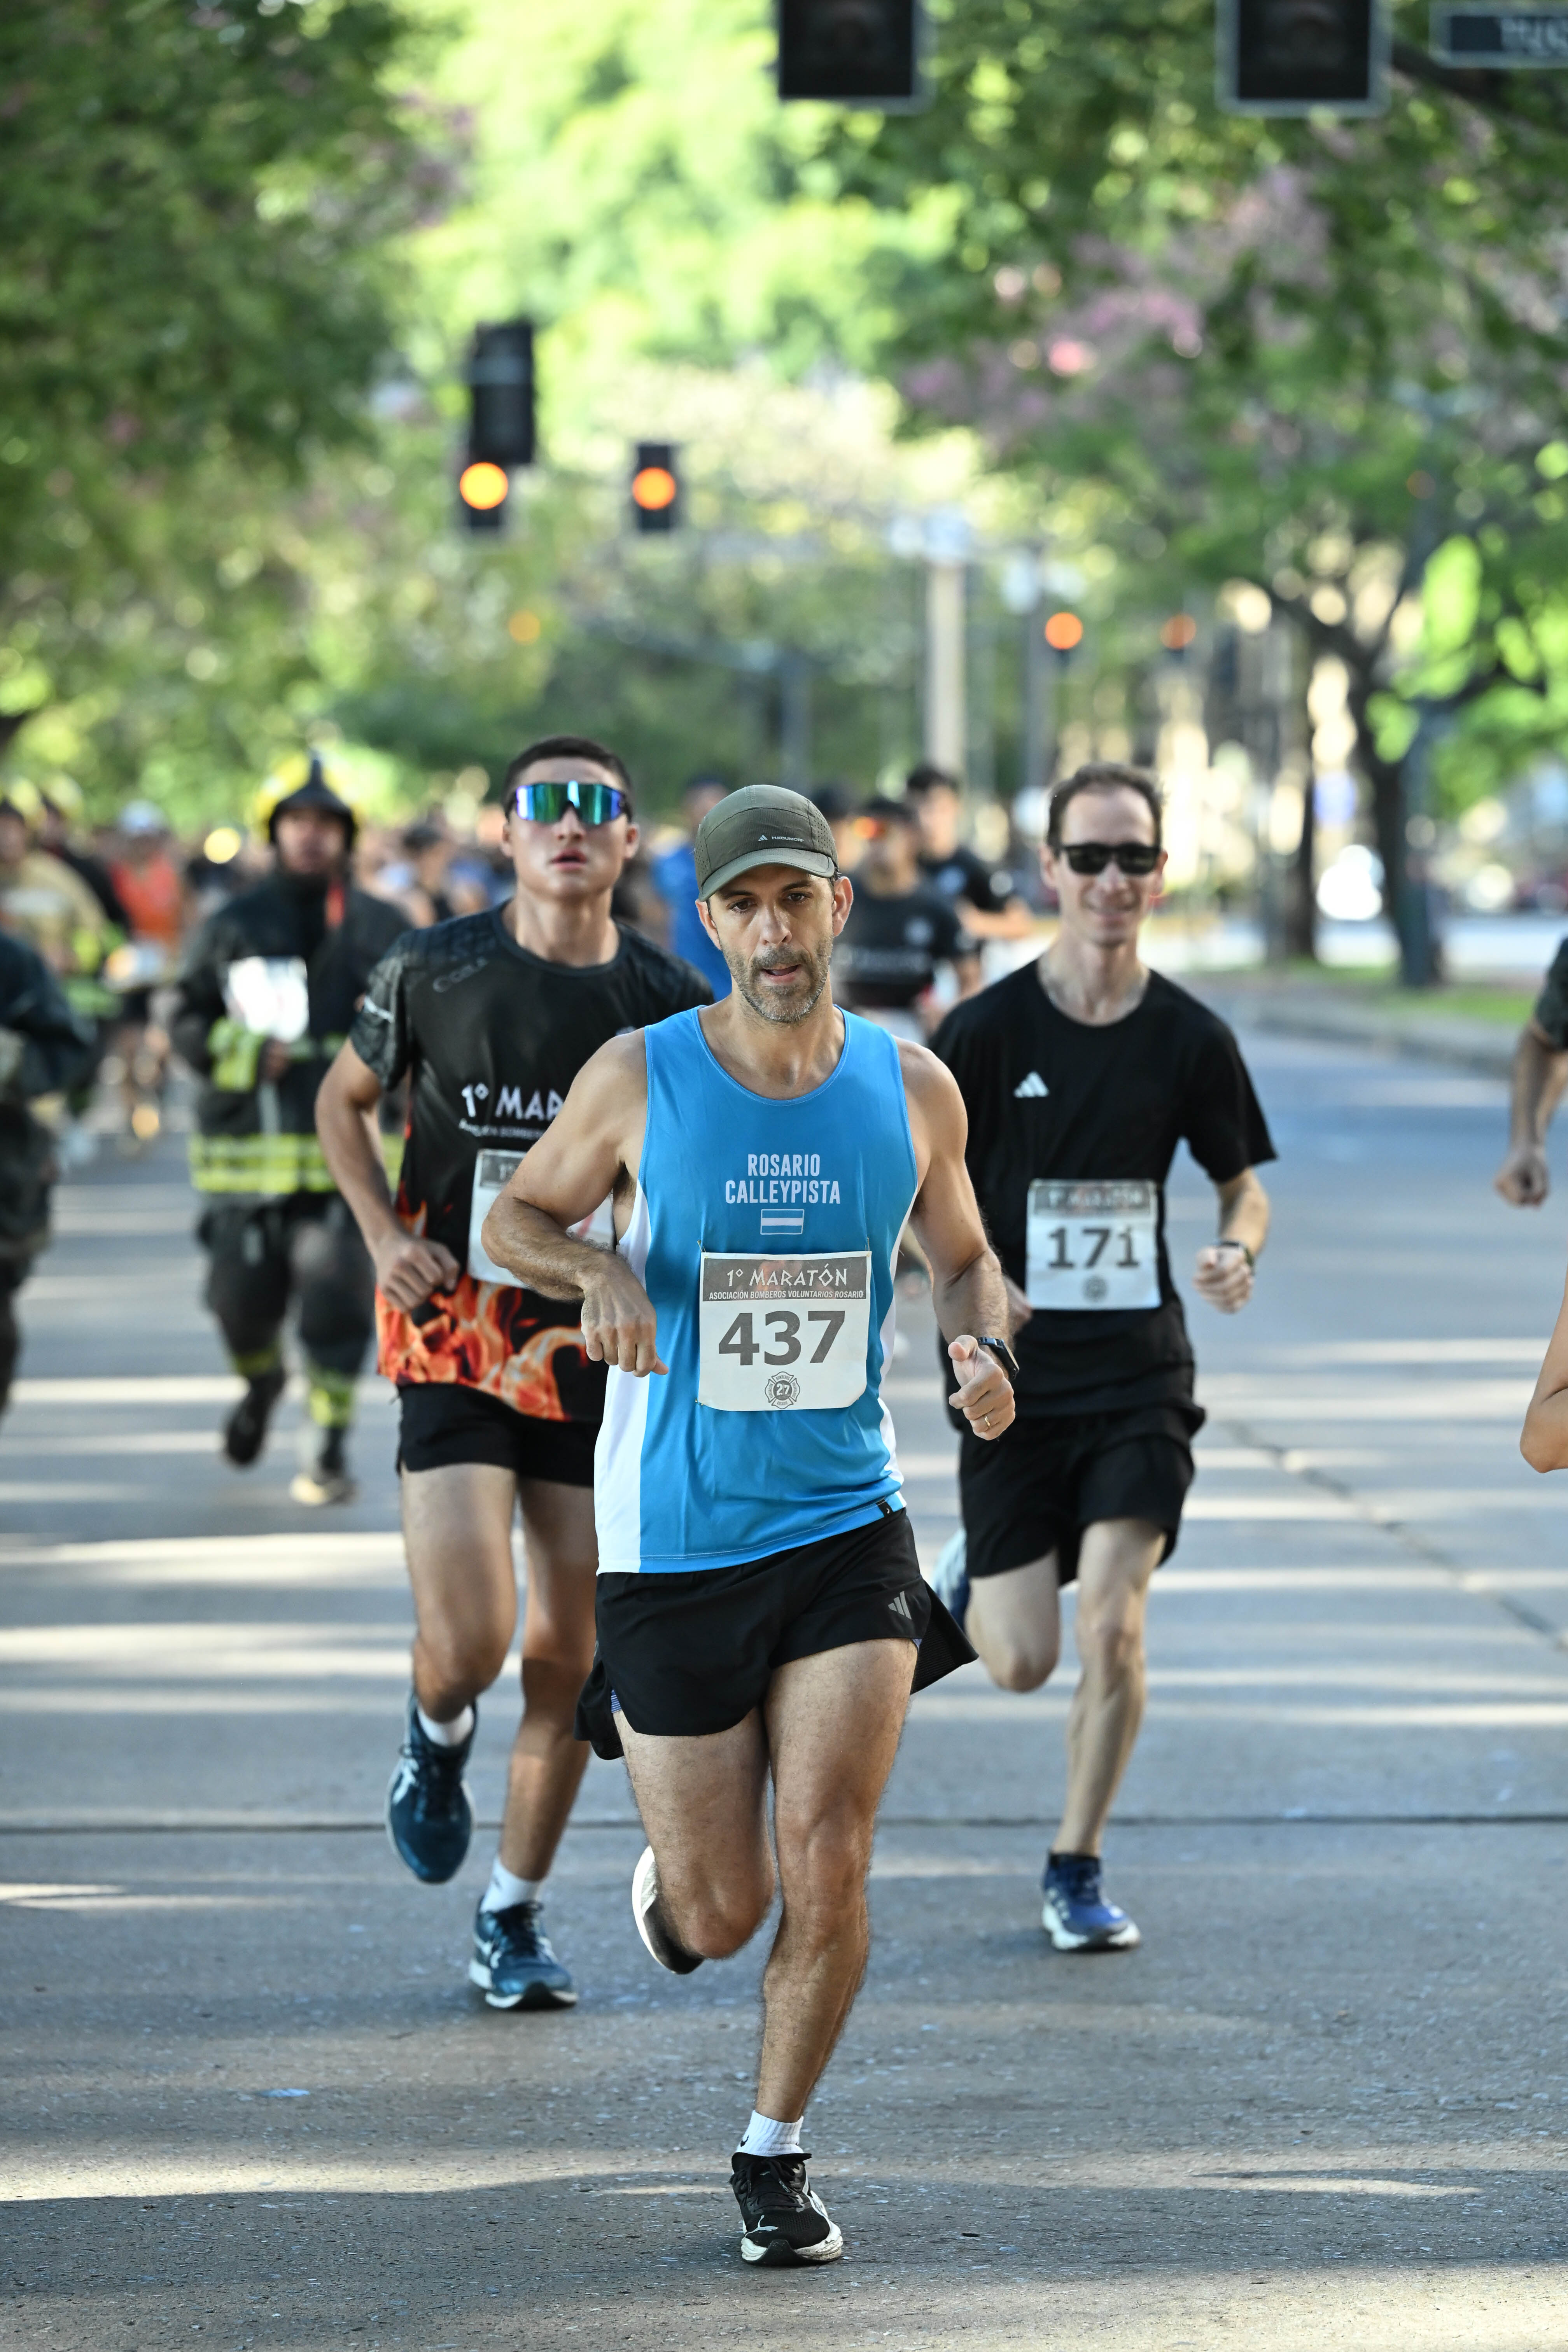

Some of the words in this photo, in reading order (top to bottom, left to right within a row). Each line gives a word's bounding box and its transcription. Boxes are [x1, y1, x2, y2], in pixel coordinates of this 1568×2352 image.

[748, 1154, 820, 1176] ROSARIO
[725, 1180, 840, 1204] CALLEYPISTA
[1048, 1227, 1140, 1269] 171
[749, 1263, 847, 1287] MARATÓN
[709, 1290, 748, 1300] ASOCIACIÓN
[750, 1290, 786, 1299] BOMBEROS
[788, 1290, 833, 1298] VOLUNTARIOS
[835, 1290, 864, 1298] ROSARIO
[719, 1311, 845, 1366] 437
[776, 1383, 790, 1396] 27
